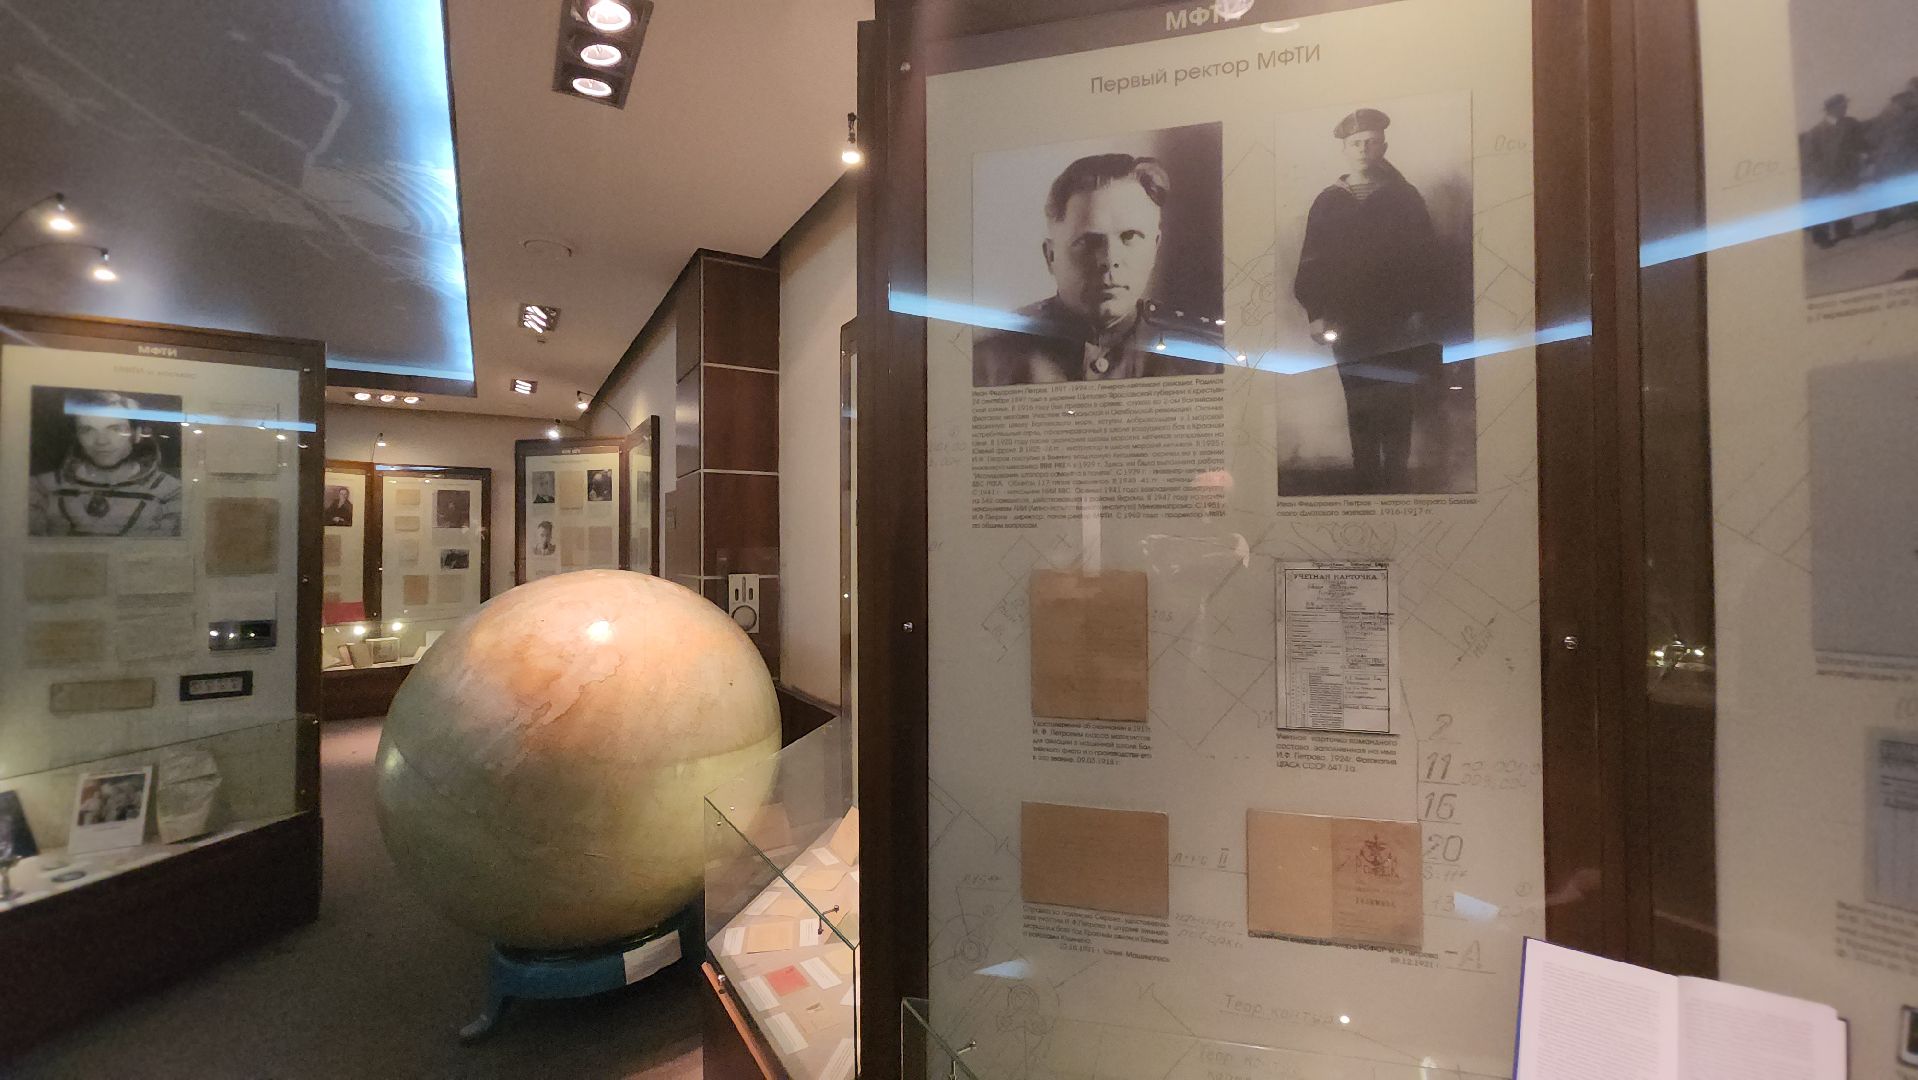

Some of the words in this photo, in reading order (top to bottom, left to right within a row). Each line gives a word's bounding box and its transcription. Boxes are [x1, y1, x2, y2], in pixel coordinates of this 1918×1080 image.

[1165, 4, 1241, 31] МФТ
[1091, 68, 1168, 94] Первый
[1174, 58, 1249, 85] ректор
[1257, 43, 1321, 70] МФТИ
[138, 345, 177, 357] МФТИ
[1427, 751, 1451, 781] 11
[1425, 792, 1457, 821] 16
[1424, 834, 1463, 863] 20
